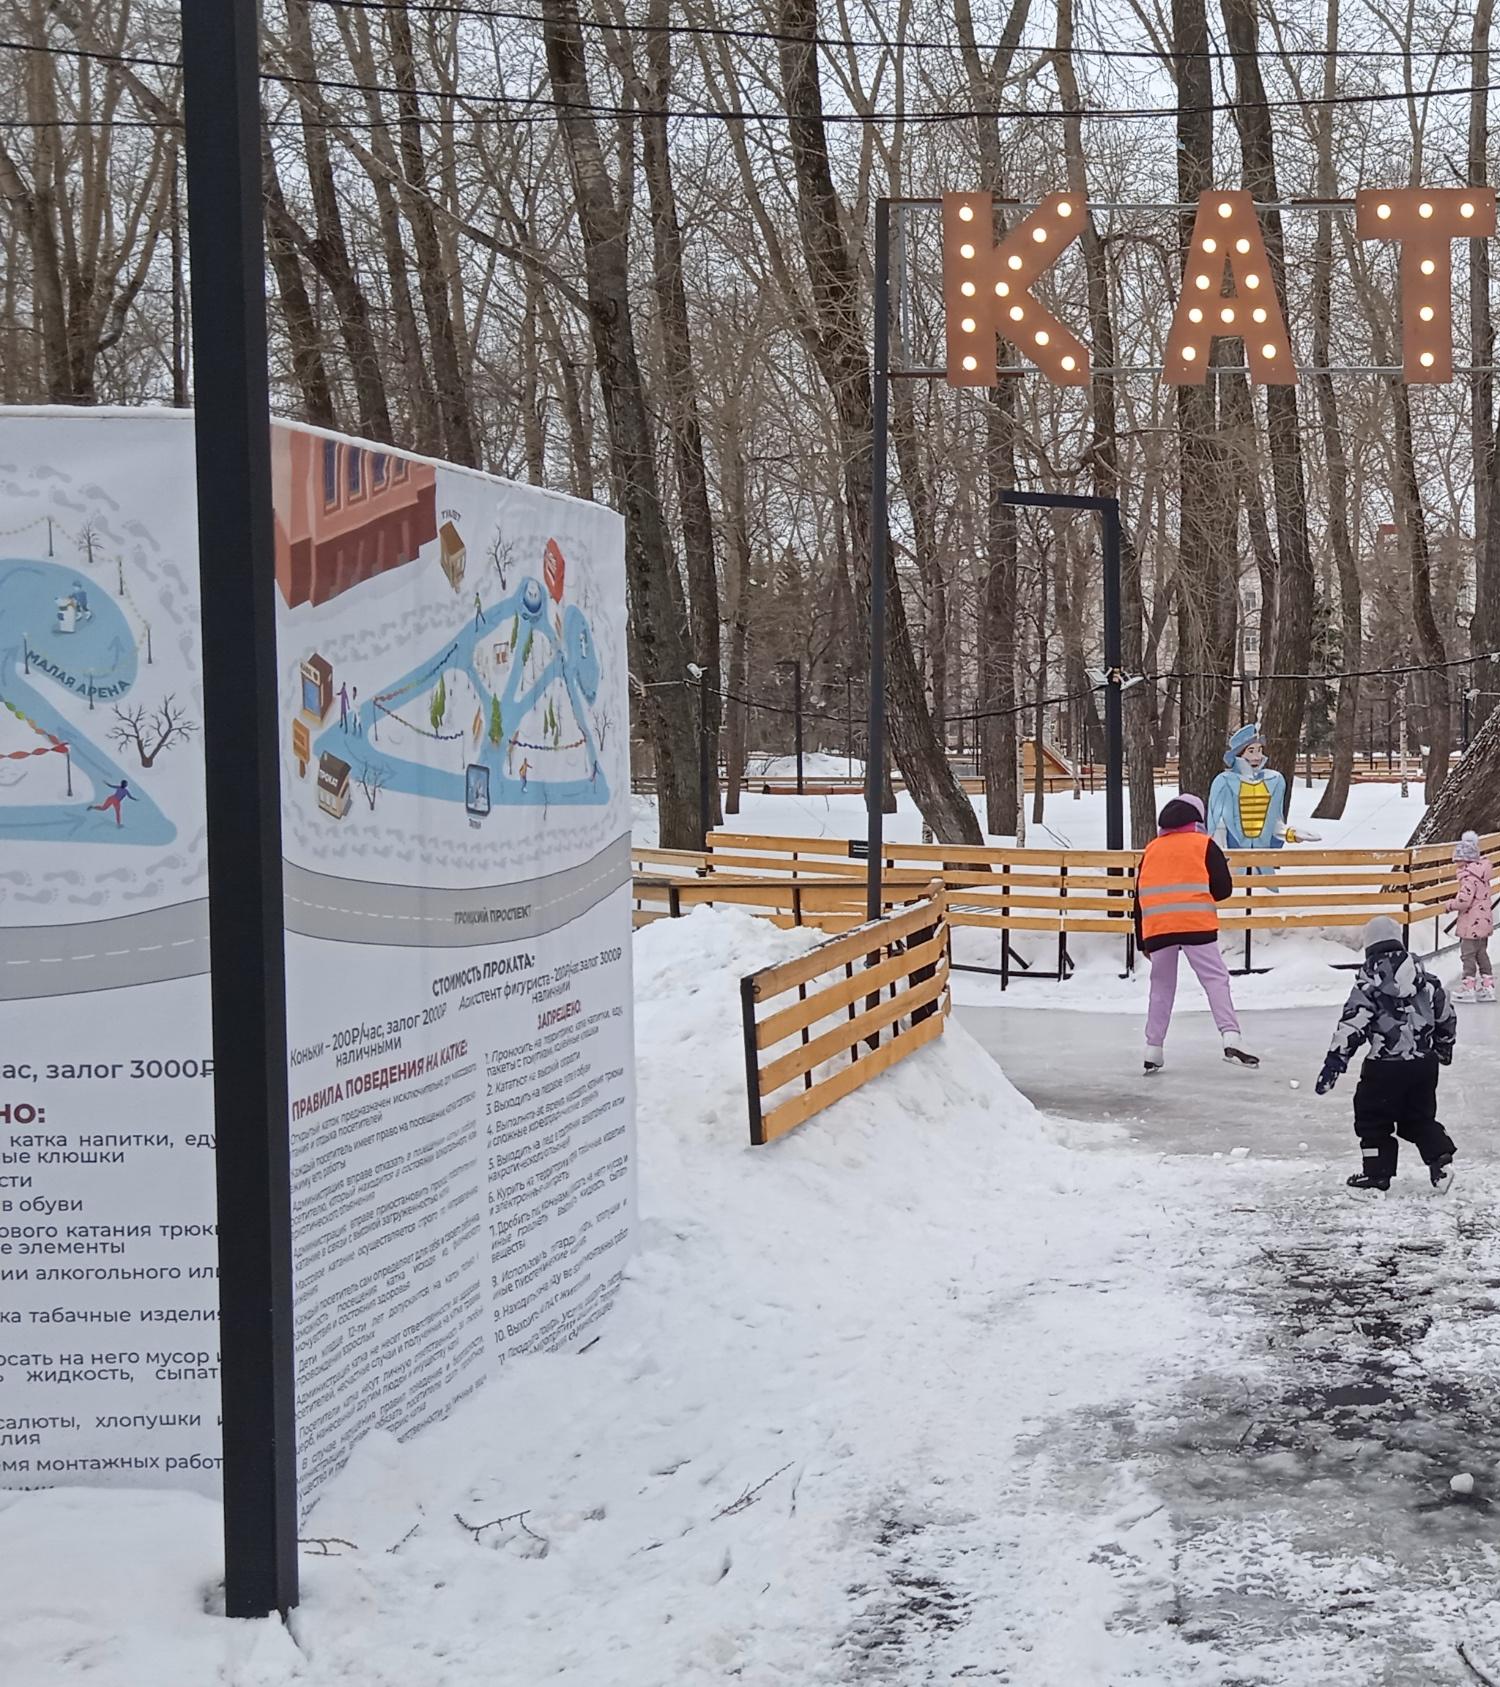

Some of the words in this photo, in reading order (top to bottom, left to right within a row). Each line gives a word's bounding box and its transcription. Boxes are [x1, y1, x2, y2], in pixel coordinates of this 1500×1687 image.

[26, 650, 77, 688] МАЛАЯ
[76, 680, 131, 698] АРЕНА
[490, 904, 532, 922] ПРОСПЕКТ
[432, 965, 481, 997] СТОИМОСТЬ
[482, 952, 535, 979] ПРОКАТА:
[503, 973, 549, 1000] фигуриста
[290, 1041, 323, 1067] Коньки
[386, 1013, 419, 1035] залог
[335, 1035, 401, 1068] наличными
[491, 1041, 532, 1063] Проносить
[534, 1038, 541, 1047] на
[46, 1063, 124, 1080] залог
[486, 1060, 515, 1077] пакеты
[517, 1058, 521, 1068] с
[292, 1082, 342, 1122] ПРАВИЛА
[345, 1056, 424, 1099] ПОВЕДЕНИЯ
[425, 1051, 438, 1072] НА
[440, 1038, 467, 1066] КАТКЕ:
[486, 1082, 492, 1097] 2.
[495, 1074, 527, 1093] Кататься
[321, 1116, 339, 1130] каток
[341, 1097, 390, 1123] предназначен
[486, 1102, 492, 1116] 3.
[493, 1092, 531, 1113] Выходить
[316, 1129, 336, 1147] отдыха
[338, 1110, 382, 1136] посетителей
[486, 1124, 493, 1135] 4.
[492, 1125, 527, 1147] сложные
[10, 1135, 68, 1148] катка
[79, 1134, 175, 1149] напитки,
[316, 1143, 352, 1165] посетитель
[353, 1133, 375, 1150] имеет
[376, 1125, 398, 1142] право
[399, 1121, 408, 1132] на
[2, 1151, 31, 1164] ые
[37, 1151, 125, 1164] клюшки
[488, 1156, 494, 1170] 5.
[496, 1144, 530, 1167] Выходить
[0, 1175, 33, 1188] сти
[312, 1170, 322, 1183] его
[323, 1159, 346, 1178] работы
[292, 1179, 344, 1212] Администрация
[346, 1167, 372, 1186] вправе
[374, 1155, 404, 1174] отказать
[328, 1185, 355, 1207] который
[358, 1170, 394, 1193] находится
[488, 1190, 494, 1204] 6.
[496, 1181, 525, 1201] Курить
[2, 1200, 13, 1212] в
[19, 1196, 84, 1216] обуви
[0, 1226, 58, 1239] ового
[66, 1225, 152, 1238] катания
[294, 1223, 346, 1259] Администрация
[350, 1209, 374, 1229] вправе
[376, 1186, 428, 1219] приостановить
[295, 1249, 320, 1272] катание
[321, 1246, 325, 1257] в
[327, 1237, 346, 1254] связи
[348, 1233, 352, 1243] с
[353, 1217, 380, 1241] высокой
[382, 1193, 438, 1226] загруженностью
[488, 1224, 497, 1236] 7.
[497, 1211, 530, 1236] Дробить
[1, 1242, 13, 1255] е
[19, 1241, 125, 1255] элементы
[491, 1232, 511, 1250] иные
[295, 1266, 324, 1291] Массовое
[327, 1250, 354, 1271] катание
[358, 1222, 415, 1256] осуществляется
[1, 1269, 28, 1281] ии
[36, 1267, 181, 1281] алкогольного
[319, 1283, 358, 1308] посетитель
[359, 1274, 372, 1288] сам
[373, 1252, 413, 1281] определяет
[337, 1284, 377, 1312] посещения
[386, 1270, 405, 1286] катка
[413, 1254, 435, 1273] исходя
[491, 1274, 498, 1288] 8.
[0, 1312, 21, 1324] ка
[29, 1307, 131, 1324] табачные
[332, 1319, 336, 1328] и
[338, 1298, 376, 1325] состояния
[377, 1280, 410, 1305] здоровья
[494, 1309, 501, 1322] 9.
[298, 1353, 316, 1373] Дети
[348, 1321, 366, 1338] 12-ти
[371, 1312, 384, 1327] лет
[433, 1279, 441, 1290] на
[494, 1328, 505, 1343] 10.
[342, 1330, 375, 1356] взрослых
[60, 1353, 84, 1366] на
[91, 1352, 140, 1365] него
[146, 1352, 209, 1370] мусор
[296, 1363, 350, 1405] Администрация
[352, 1351, 368, 1367] катка
[370, 1344, 379, 1356] не
[381, 1331, 400, 1349] несет
[337, 1362, 370, 1392] несчастные
[371, 1347, 396, 1368] случаи
[397, 1343, 402, 1353] и
[27, 1369, 134, 1383] жидкость,
[299, 1404, 340, 1438] Посетители
[361, 1375, 379, 1394] несут
[383, 1358, 411, 1381] личную
[356, 1387, 380, 1412] другим
[0, 1416, 81, 1431] салюты,
[96, 1413, 201, 1429] хлопушки
[302, 1456, 307, 1470] В
[311, 1439, 336, 1463] случае
[340, 1410, 376, 1444] нарушения
[380, 1391, 406, 1418] правил
[408, 1366, 442, 1393] поведения
[374, 1407, 402, 1429] обязать
[1, 1433, 41, 1446] лия
[37, 1456, 159, 1472] монтажных
[166, 1453, 224, 1472] работ
[328, 1466, 333, 1476] и
